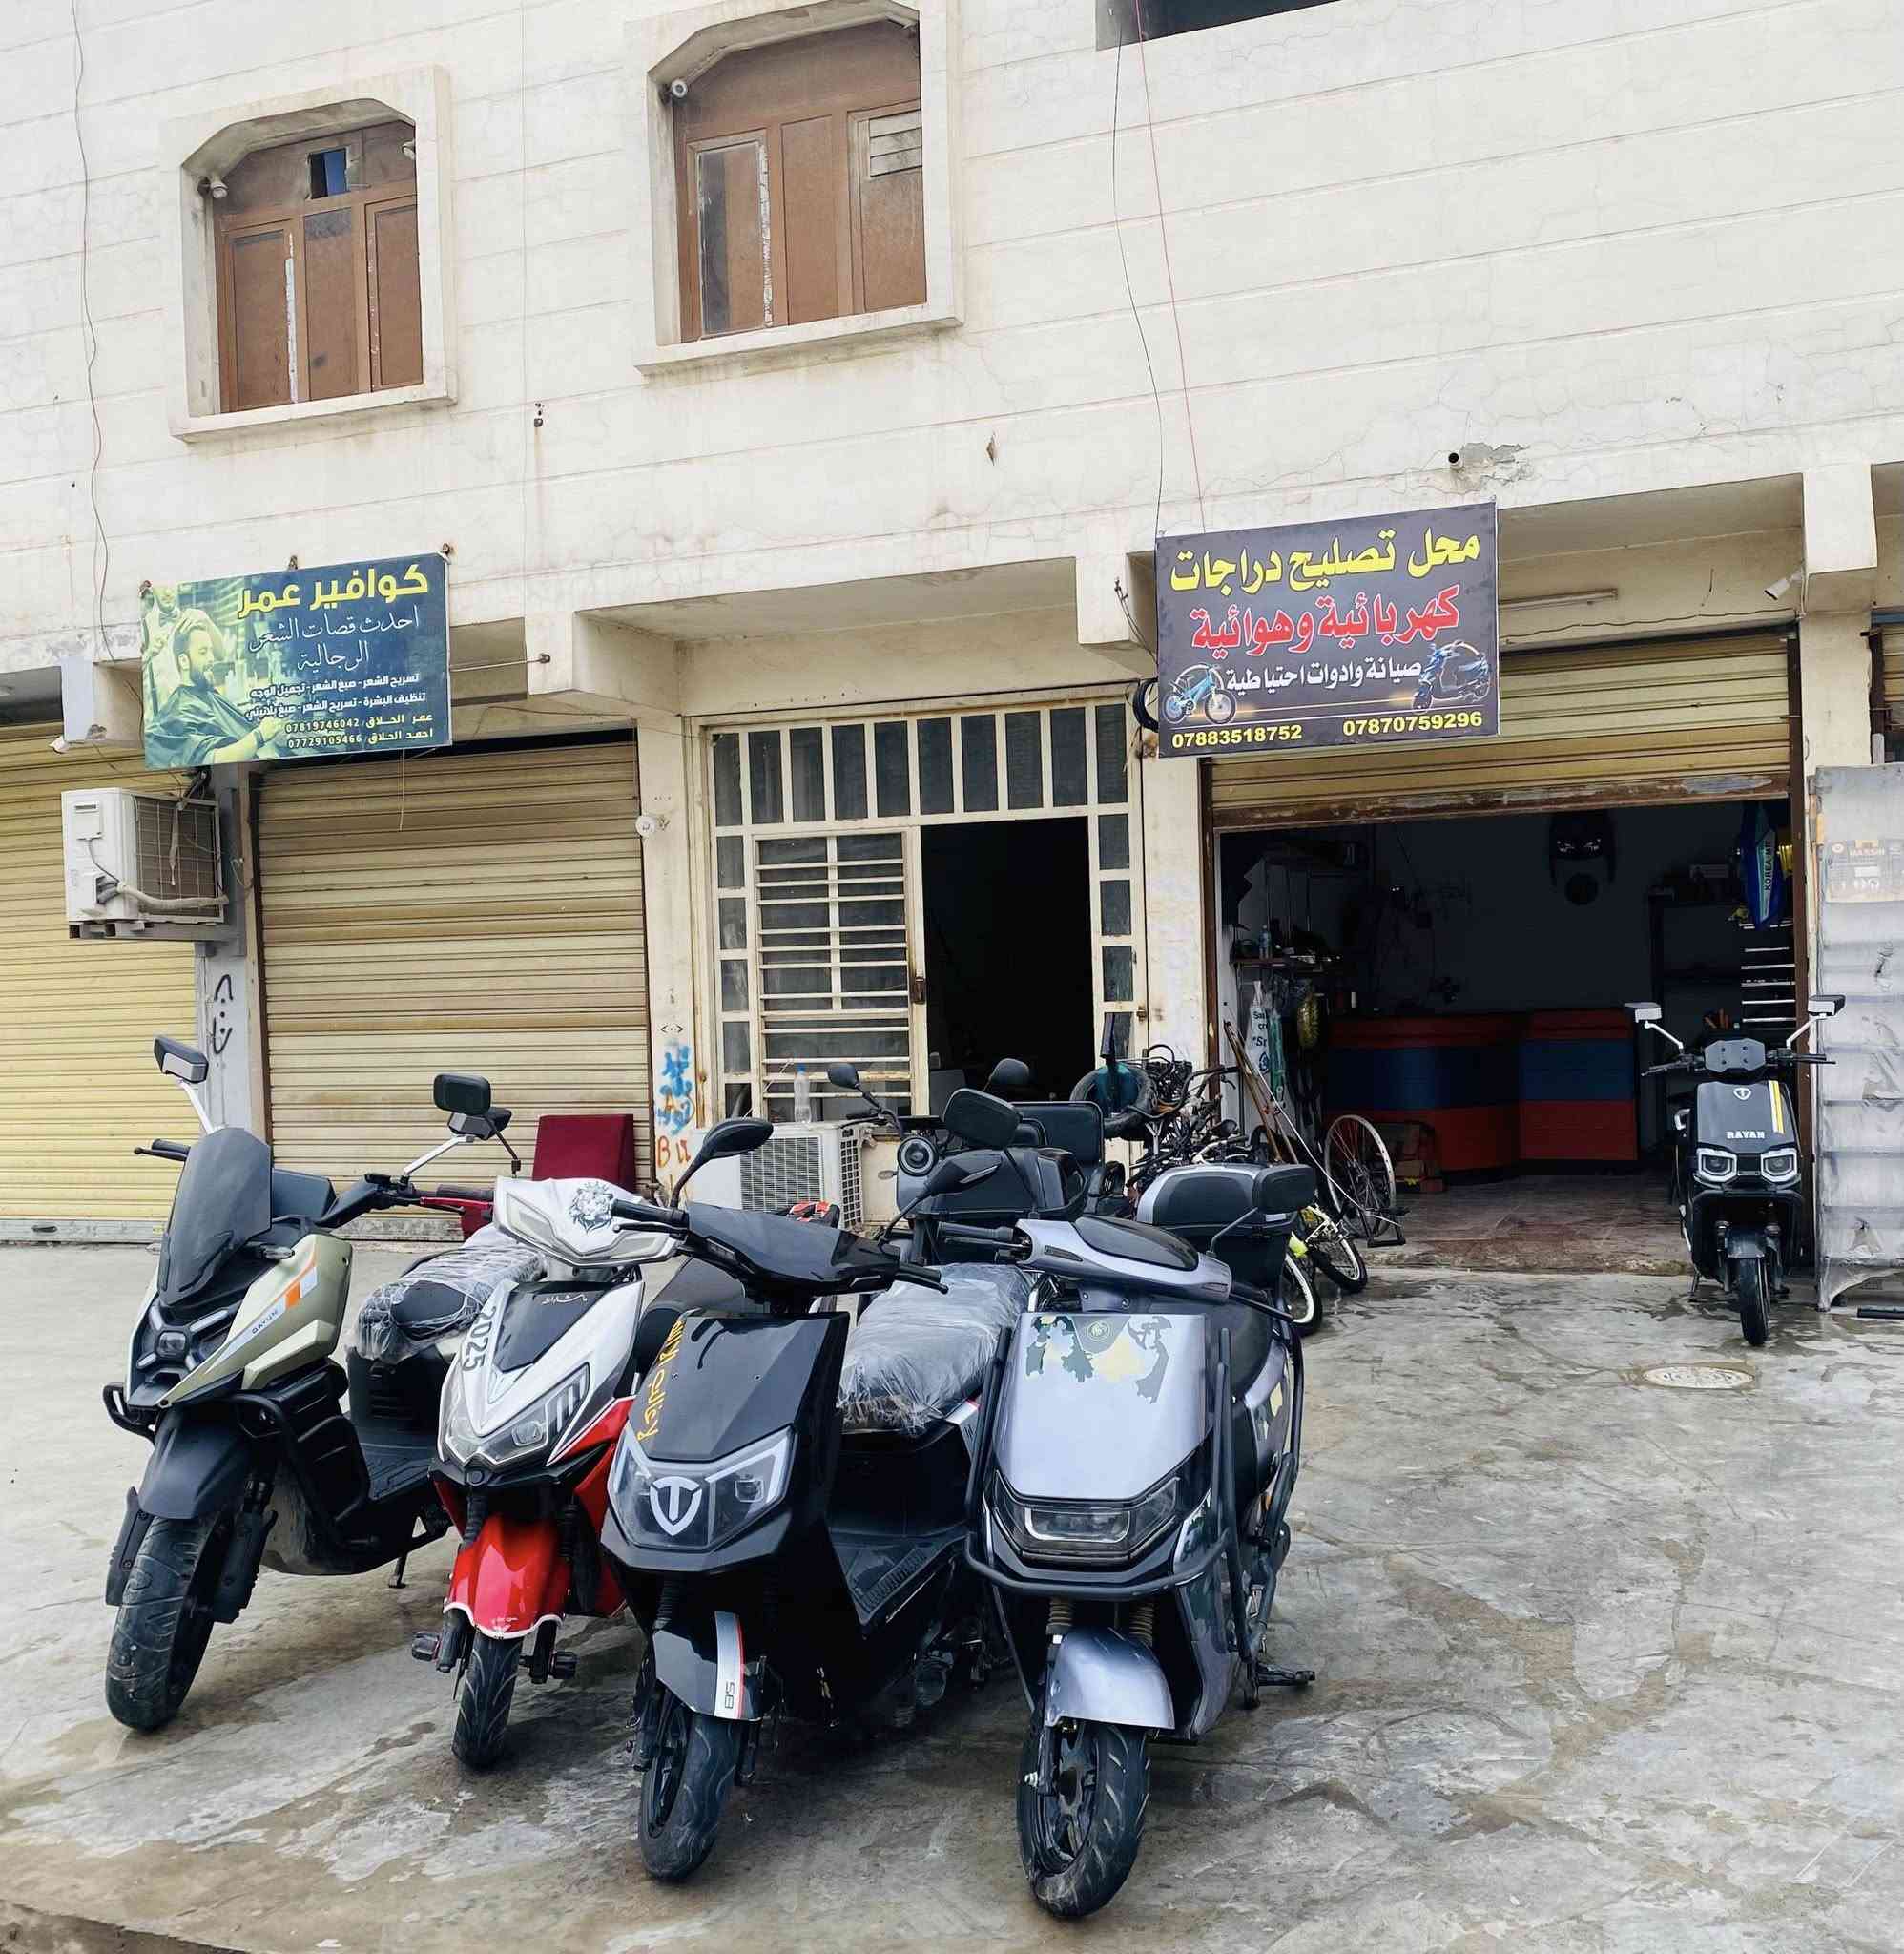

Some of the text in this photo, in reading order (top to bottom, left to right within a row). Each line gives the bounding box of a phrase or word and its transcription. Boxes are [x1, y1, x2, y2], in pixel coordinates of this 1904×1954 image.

[1169, 527, 1480, 596] محل تصليح دراجات
[238, 564, 428, 619] كوافير عمر
[249, 605, 420, 653] احدث قصات الشعر
[1190, 584, 1460, 660] كهربائية وهوائية
[297, 640, 370, 674] الرجالية
[250, 673, 420, 699] تسريح الشعر صبغ الشعر تجميل الوجه
[1225, 655, 1422, 696] صيانة وادوات احتياطية
[302, 700, 328, 714] الشعر
[328, 698, 357, 713] تسريح
[363, 695, 393, 707] البشرة
[394, 692, 426, 705] تنظيف
[285, 718, 359, 733] 07819746042
[411, 714, 433, 724] عمر
[1342, 711, 1482, 736] 07870759296
[405, 728, 433, 739] احمد
[1171, 724, 1302, 748] 07883518752
[1726, 1130, 1765, 1139] RAYAN
[462, 1305, 497, 1372] 2025
